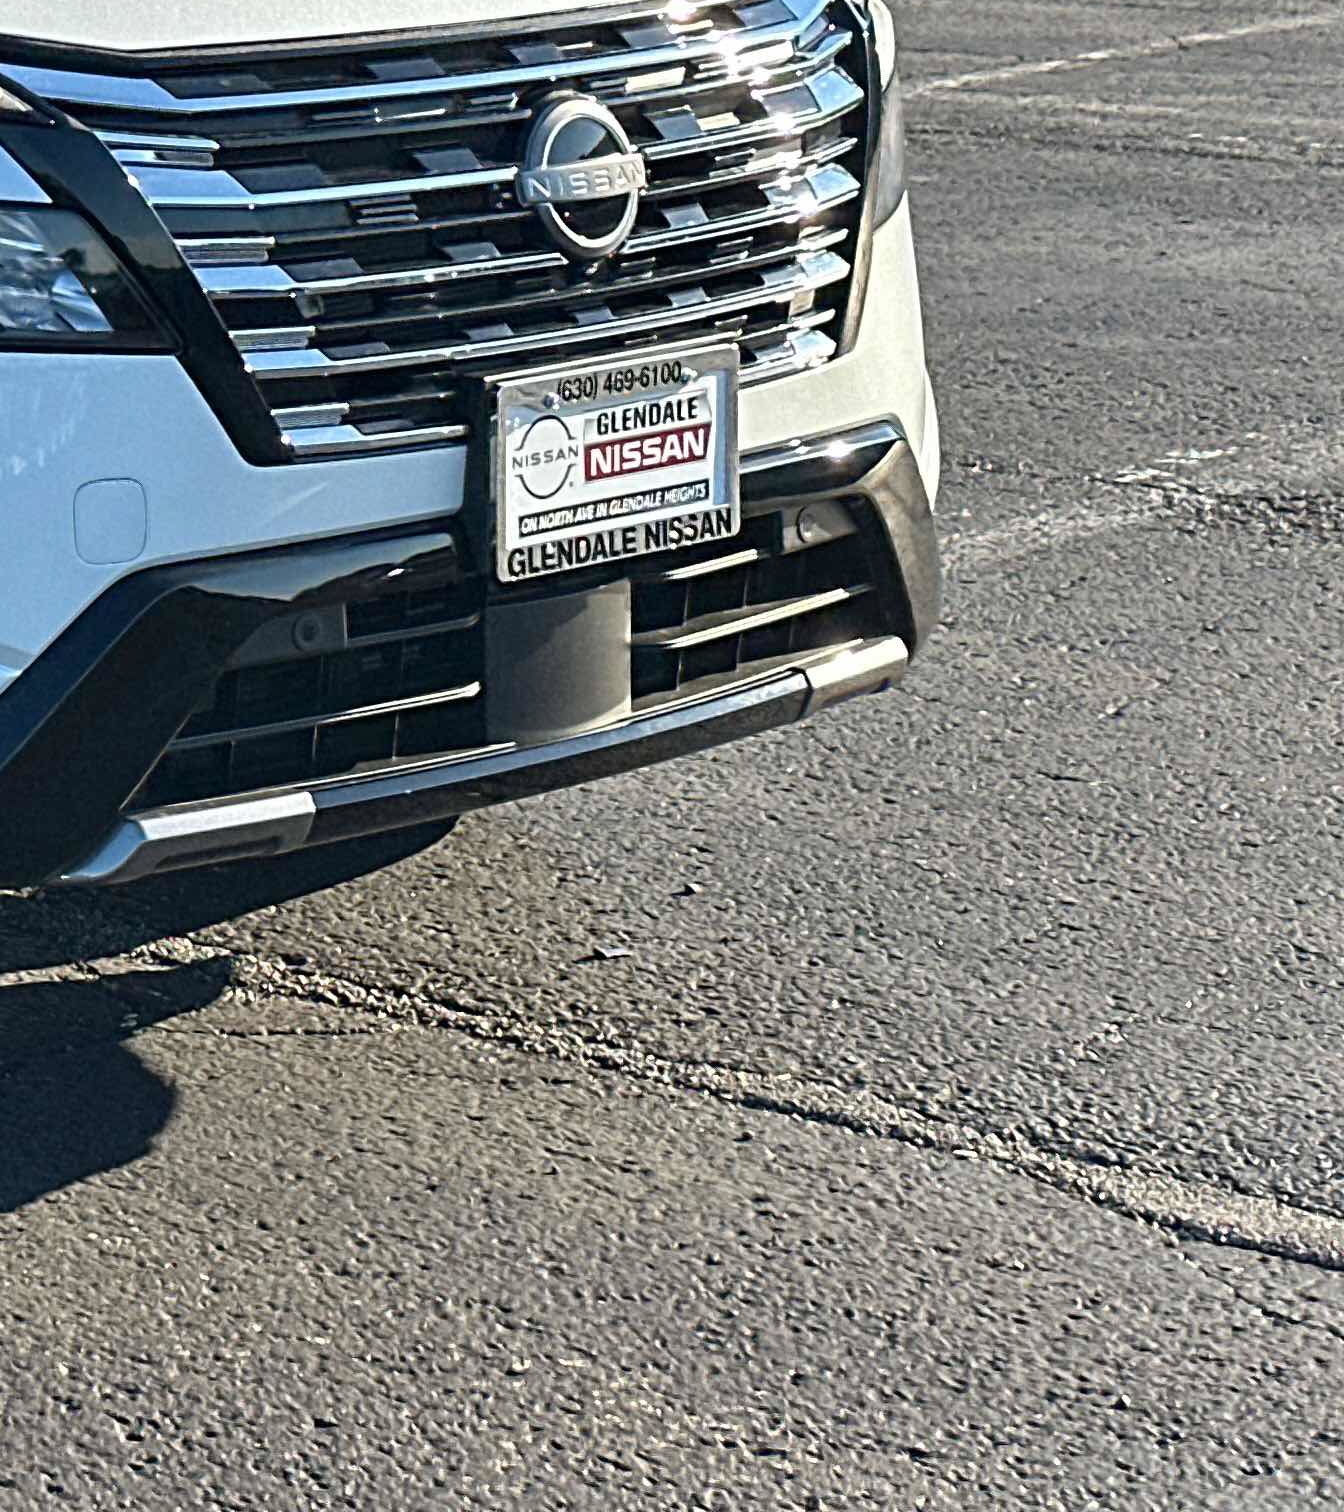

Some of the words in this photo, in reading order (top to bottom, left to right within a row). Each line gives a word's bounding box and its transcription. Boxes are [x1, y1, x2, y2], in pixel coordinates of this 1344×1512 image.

[527, 163, 642, 197] NISSAN
[557, 373, 598, 402] (630)
[603, 360, 682, 393] 469-6100
[597, 396, 699, 436] GLENDALE
[512, 444, 579, 470] NISSAN
[590, 428, 705, 476] NISSAN
[521, 517, 538, 534] ON
[539, 510, 574, 529] NORTH
[596, 502, 608, 518] IN
[609, 491, 662, 515] GLENDALE
[664, 482, 707, 504] HEIGHTS
[507, 526, 638, 577] GLENDALE
[644, 507, 732, 550] NISSAN
